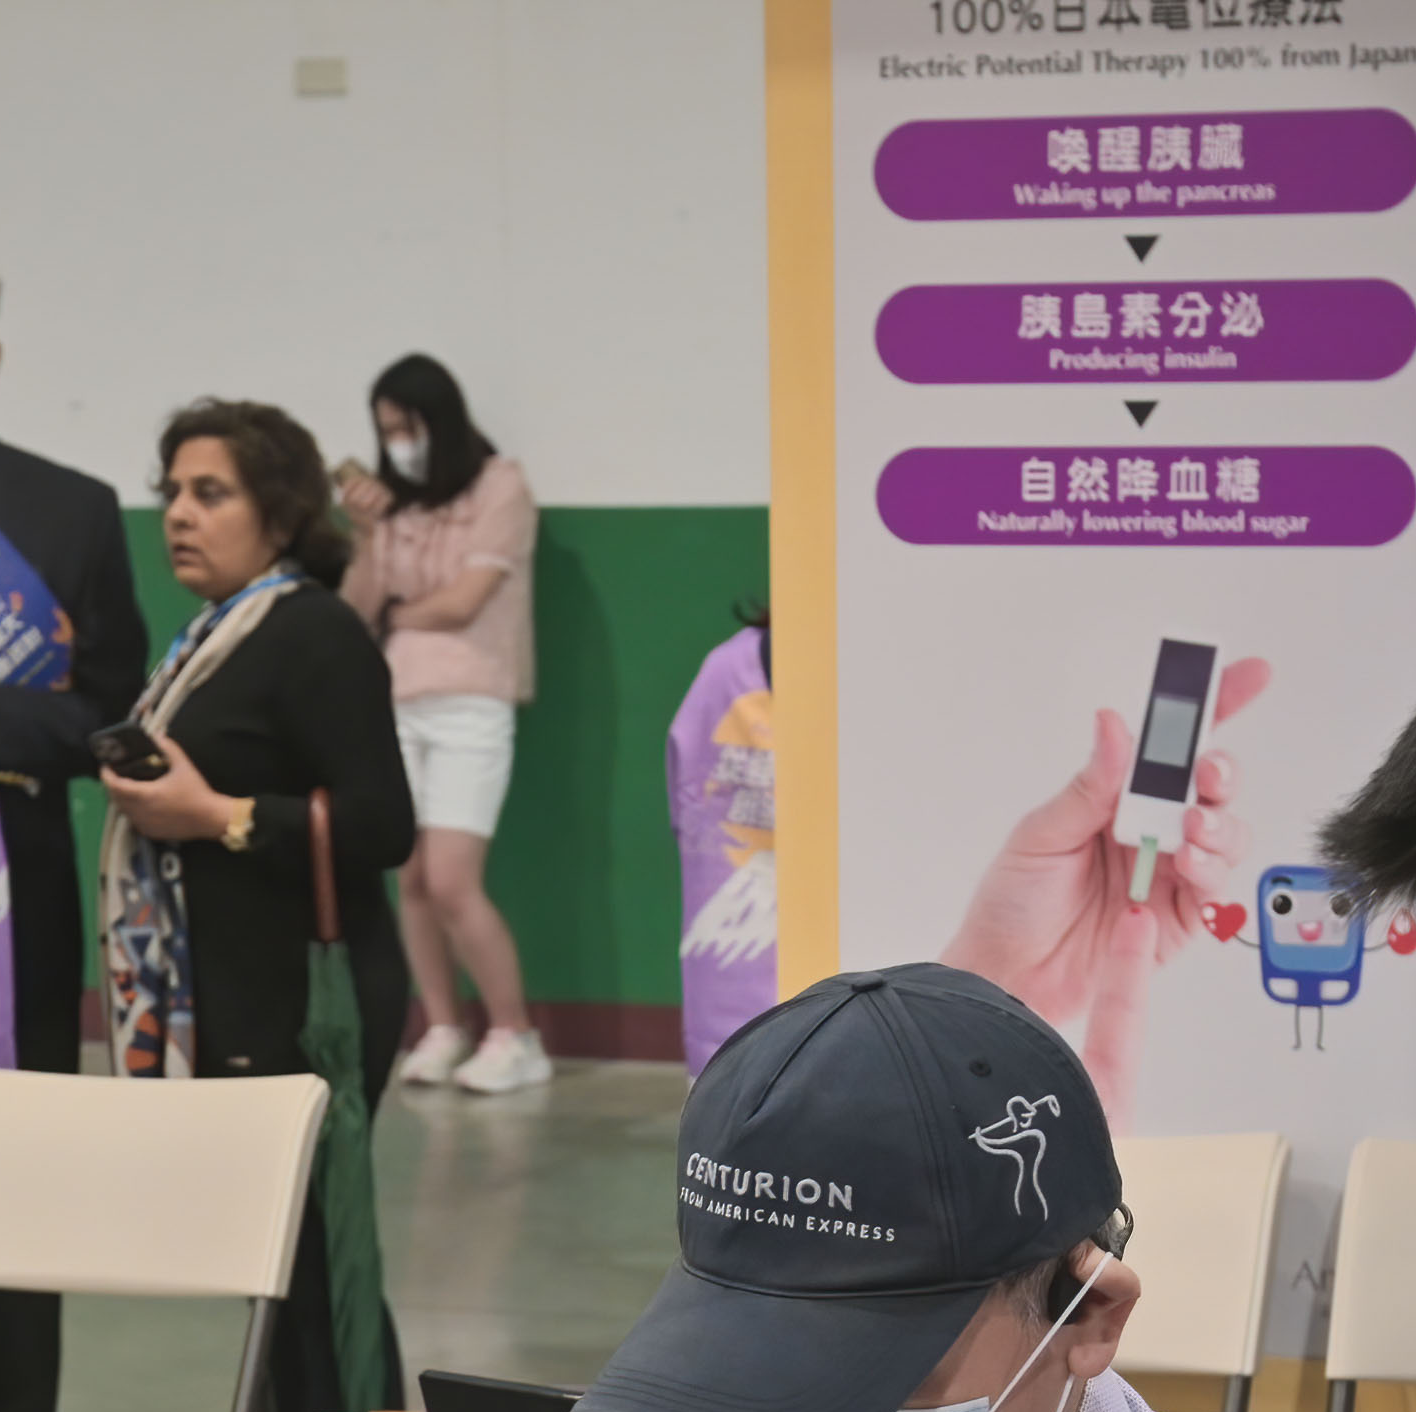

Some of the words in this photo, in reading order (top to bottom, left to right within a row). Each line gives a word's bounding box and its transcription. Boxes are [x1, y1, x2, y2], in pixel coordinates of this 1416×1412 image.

[879, 54, 967, 79] Electric
[977, 51, 1083, 76] Potential
[1093, 49, 1186, 78] Therapy
[1199, 47, 1270, 70] 100%
[1282, 43, 1341, 67] from
[1047, 123, 1245, 174] 喚醒胰臟
[1014, 181, 1097, 210] Waking
[1101, 186, 1131, 210] up
[1136, 179, 1172, 203] the
[1176, 183, 1277, 208] pancreas
[1018, 291, 1265, 339] 胰島素分泌
[1049, 346, 1160, 376] Producing
[1164, 345, 1238, 369] insulin
[1021, 456, 1261, 503] 自然降血糖
[978, 508, 1078, 538] Naturally
[1083, 508, 1178, 539] lowering
[1182, 508, 1245, 532] blood
[1250, 515, 1310, 539] sugar
[686, 1152, 853, 1212] CENTURION
[706, 1199, 795, 1229] AMERICAN
[806, 1216, 896, 1242] EXPRESS
